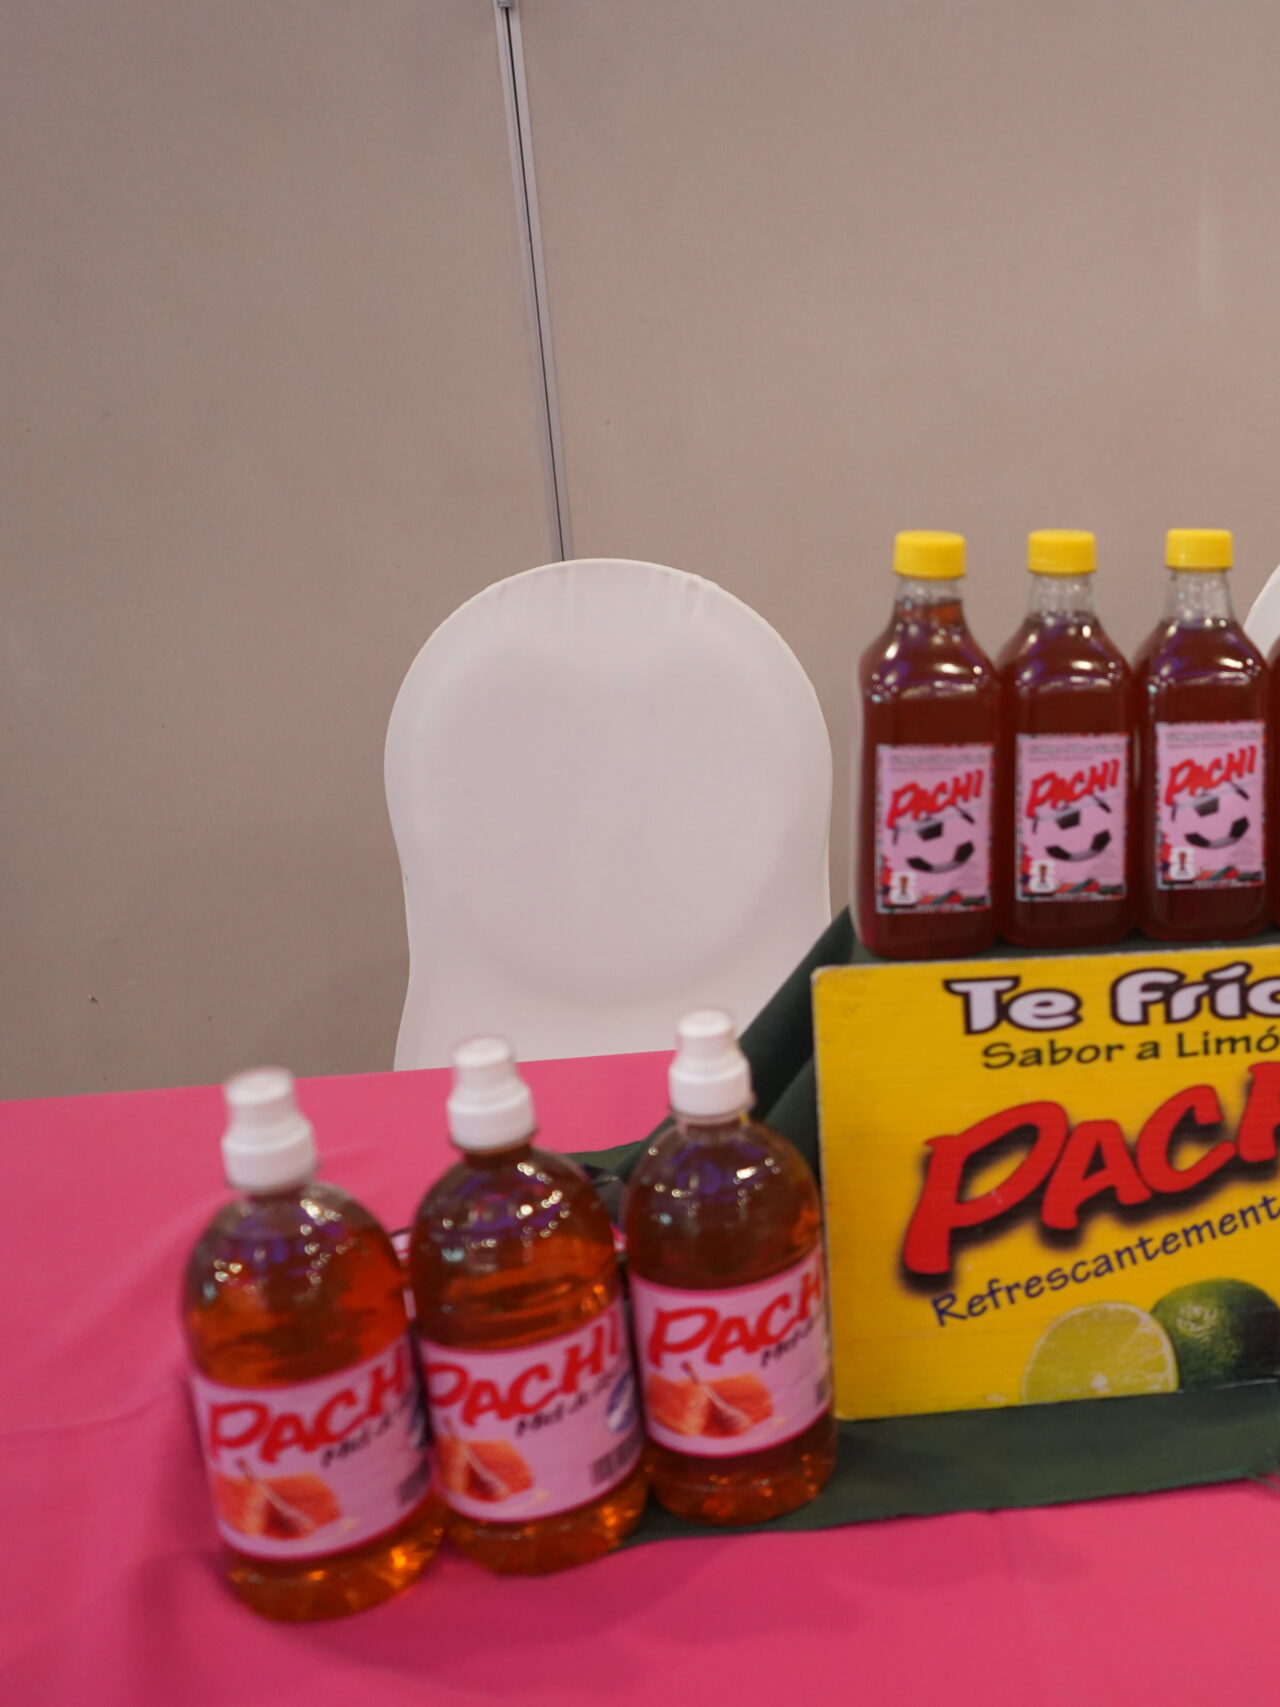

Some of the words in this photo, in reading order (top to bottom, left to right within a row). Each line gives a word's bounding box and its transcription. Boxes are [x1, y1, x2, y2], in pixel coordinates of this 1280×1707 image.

[886, 769, 984, 829] PACHI
[1026, 758, 1120, 819] PACHI
[1165, 745, 1257, 806] PACHI
[943, 975, 1082, 1035] Te
[981, 1036, 1125, 1070] Sabor
[1136, 1040, 1161, 1060] a
[647, 1254, 824, 1369] PACH
[209, 1344, 406, 1464] PACH
